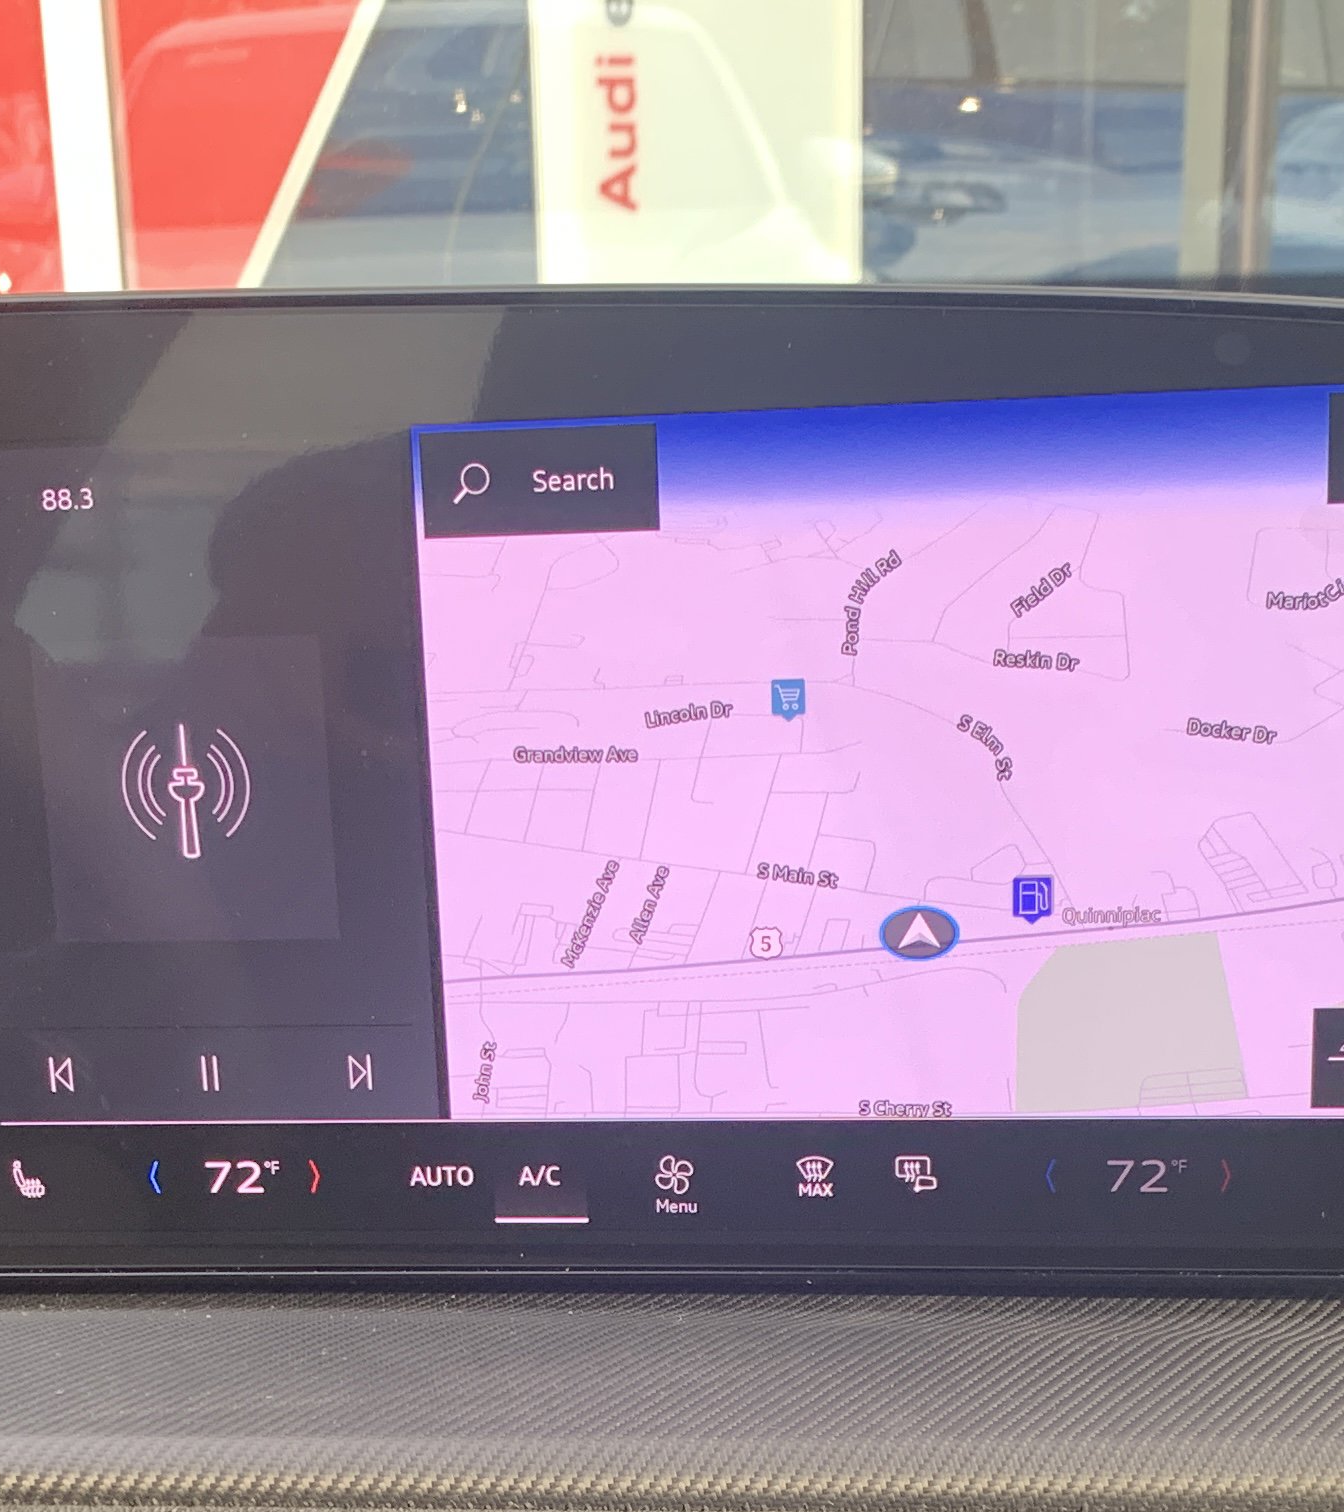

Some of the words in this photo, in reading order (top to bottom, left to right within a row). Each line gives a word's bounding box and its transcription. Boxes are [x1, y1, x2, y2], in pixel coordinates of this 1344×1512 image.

[595, 55, 638, 212] Audi
[532, 467, 614, 493] Search
[41, 487, 94, 512] 88.3
[876, 549, 903, 577] Rd
[848, 569, 880, 605] Hill
[1010, 577, 1053, 618] Field
[1048, 562, 1074, 589] Dr
[841, 606, 862, 655] Pond
[993, 649, 1052, 670] Reskin
[1056, 653, 1080, 672] Dr
[645, 704, 709, 728] Lincoln
[711, 701, 734, 719] Dr
[1187, 717, 1251, 741] Docker
[1253, 726, 1277, 745] Dr
[513, 746, 603, 764] Grandview
[606, 747, 639, 763] Ave
[956, 714, 974, 732] S
[971, 722, 1004, 756] Elm
[995, 757, 1013, 782] St
[642, 864, 671, 900] Ave
[757, 863, 769, 880] S
[772, 865, 816, 886] Main
[818, 871, 839, 889] St
[560, 889, 605, 969] McKenzie
[589, 859, 620, 893] Ave
[628, 899, 657, 945] Allen
[1062, 904, 1162, 927] Quinnipiac
[479, 1041, 497, 1062] St
[472, 1065, 491, 1102] John
[858, 1101, 871, 1117] S
[875, 1100, 930, 1119] Cherry
[933, 1101, 952, 1118] St
[410, 1166, 474, 1187] AUTO
[519, 1165, 561, 1189] A/C
[798, 1183, 834, 1198] MAX
[656, 1199, 698, 1215] Menu
